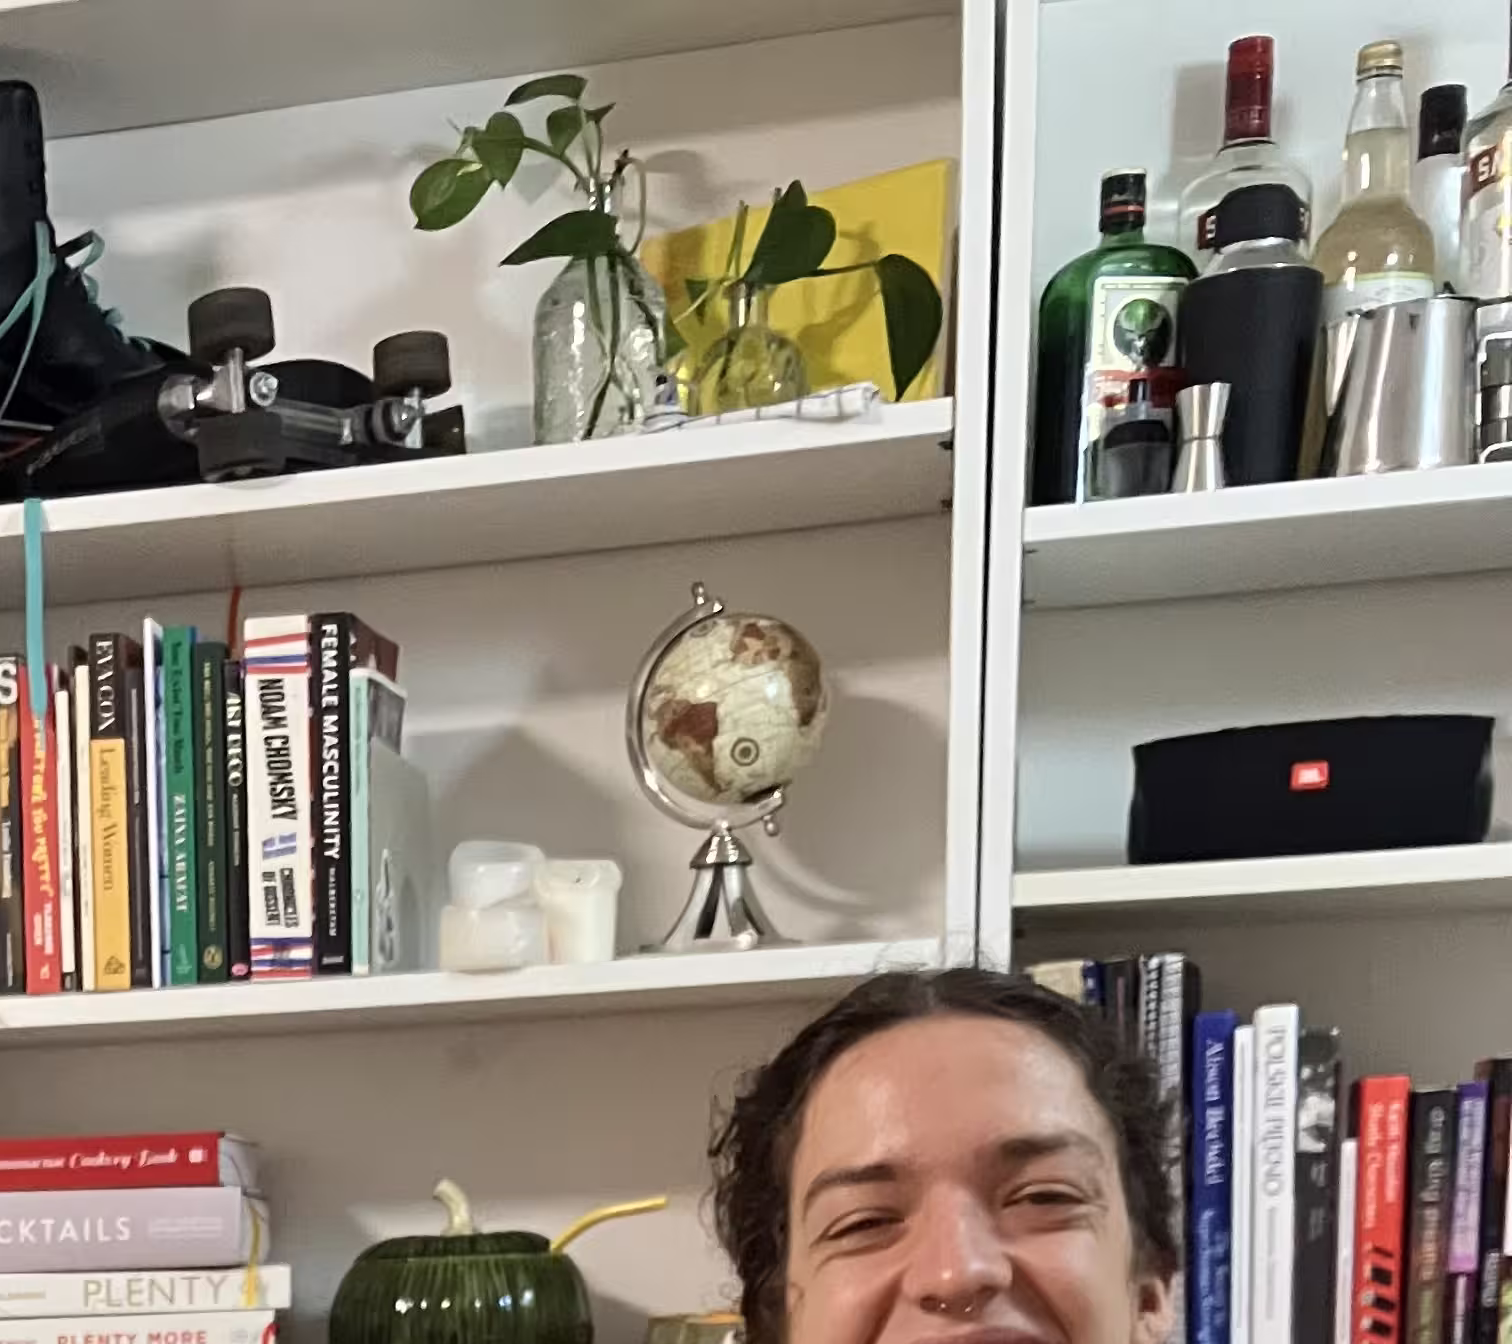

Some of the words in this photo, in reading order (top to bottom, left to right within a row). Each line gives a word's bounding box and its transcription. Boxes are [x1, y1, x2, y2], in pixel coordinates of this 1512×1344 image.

[96, 640, 114, 681] EVA
[322, 624, 338, 706] FEMALE
[97, 686, 115, 732] COX
[226, 692, 242, 728] ART
[258, 679, 288, 729] NOAM
[99, 748, 115, 818] Leading
[264, 735, 296, 820] CHOMSKY
[323, 715, 340, 859] MASCULINITY
[103, 824, 115, 891] Women
[1425, 1106, 1445, 1154] drag
[82, 1274, 229, 1308] PLENTY
